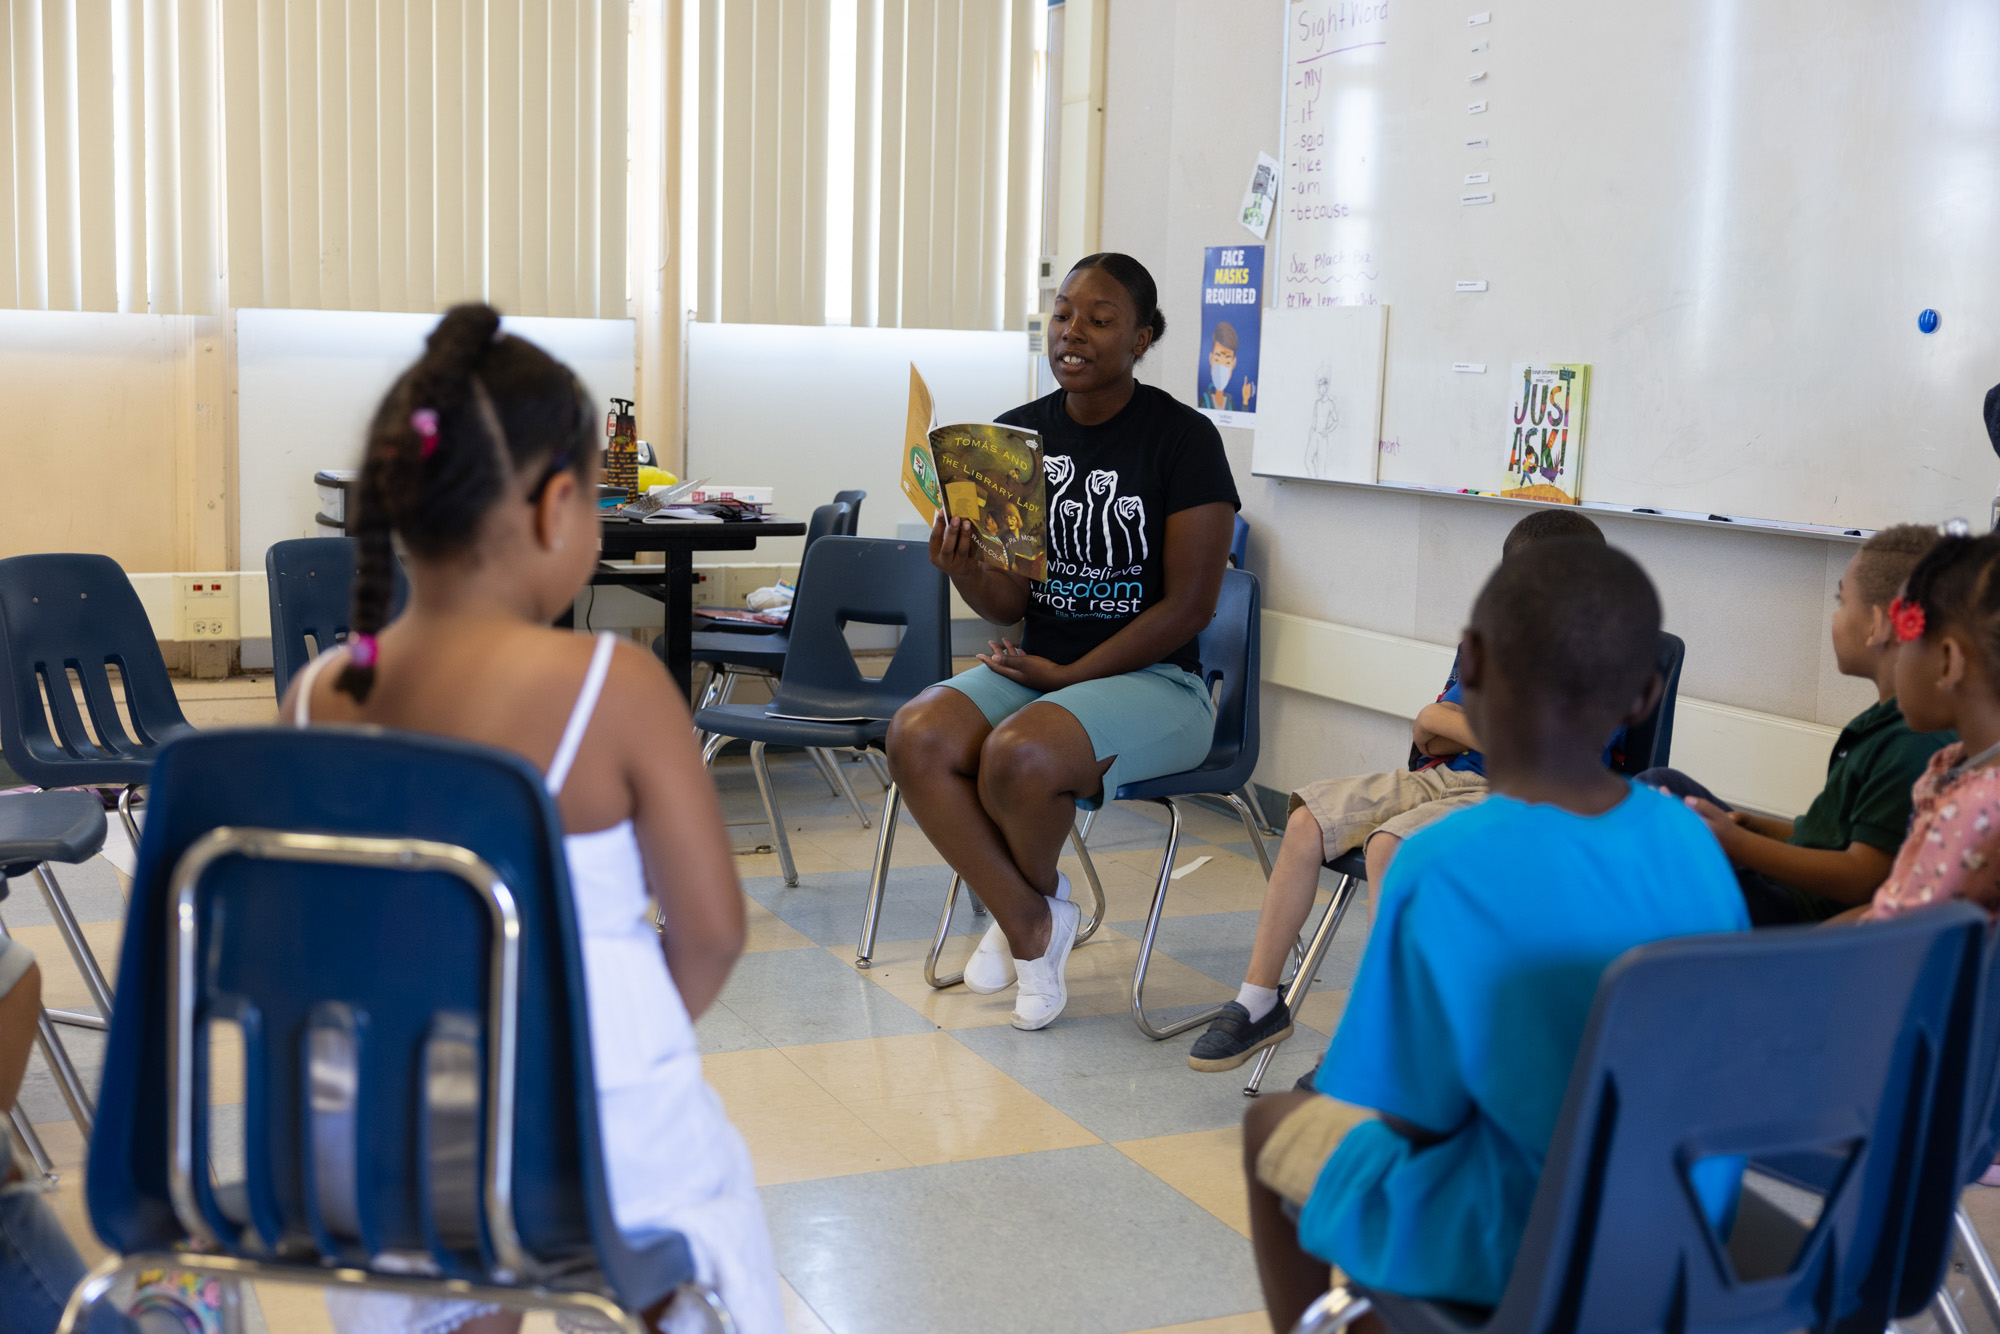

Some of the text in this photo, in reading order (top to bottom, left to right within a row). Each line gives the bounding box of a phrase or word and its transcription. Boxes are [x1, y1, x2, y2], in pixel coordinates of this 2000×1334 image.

[1298, 0, 1389, 53] Sight Word
[1221, 250, 1245, 266] FACE
[1214, 268, 1249, 284] MASKS
[1205, 287, 1256, 306] REQUIRED
[1513, 367, 1576, 427] JUST
[955, 437, 1028, 471] TOMÁS AND
[1508, 427, 1568, 475] ASK!
[942, 455, 1040, 512] THE LIBRARY LADY
[1090, 598, 1141, 613] rest
